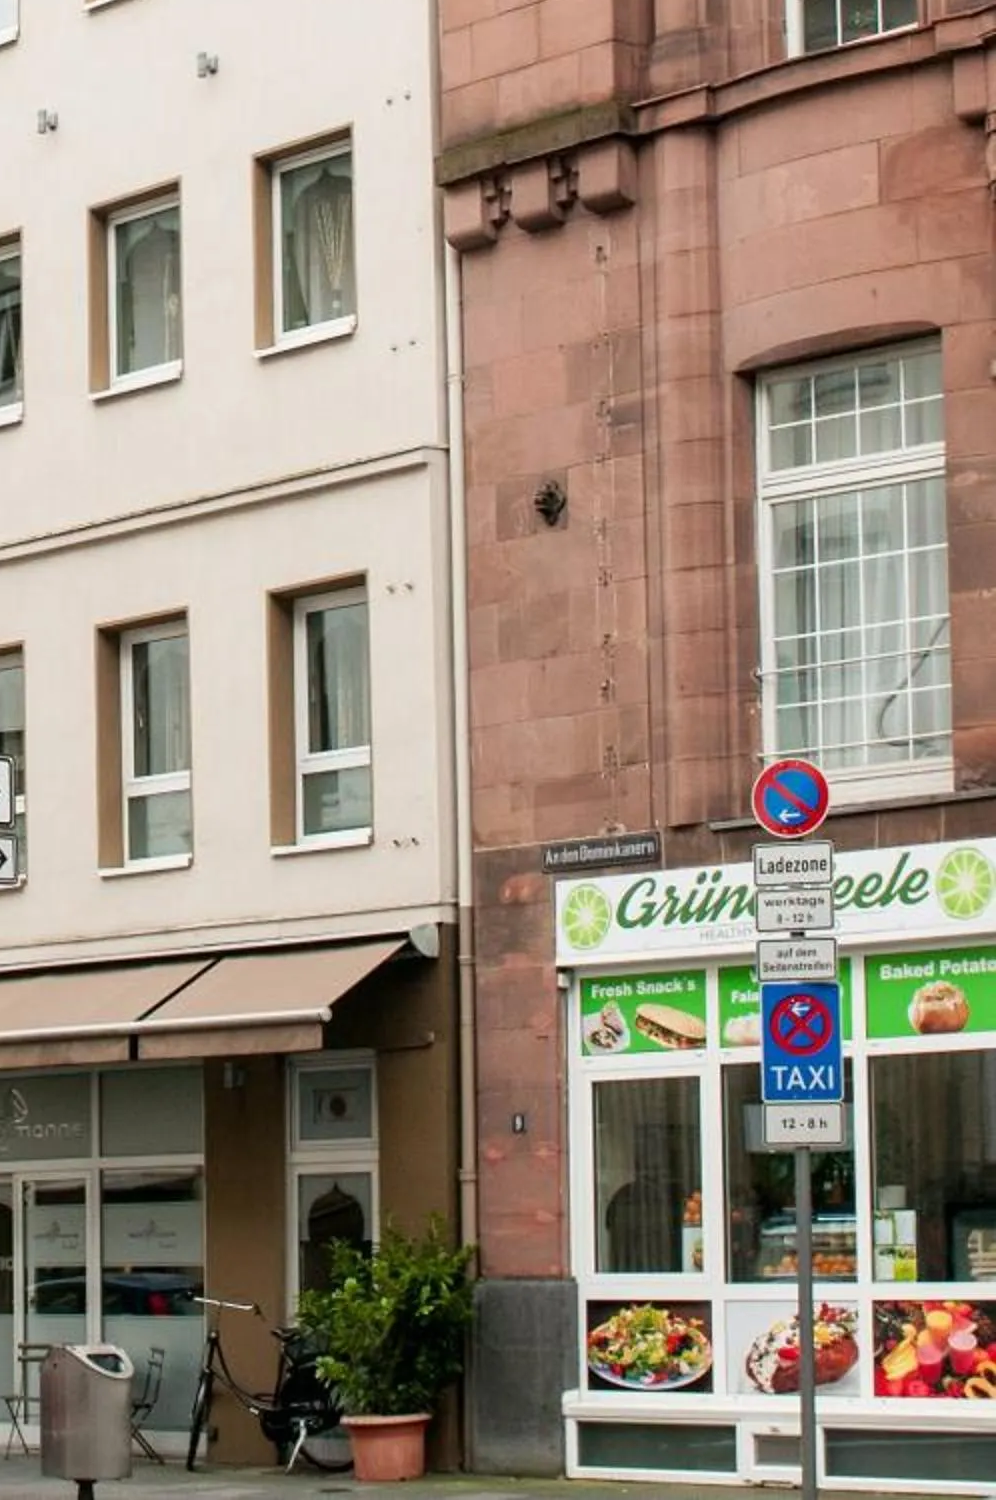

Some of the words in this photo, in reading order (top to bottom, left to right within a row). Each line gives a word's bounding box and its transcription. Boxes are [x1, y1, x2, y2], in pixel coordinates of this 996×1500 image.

[759, 857, 827, 875] Ladezone
[616, 870, 755, 929] Grün
[833, 852, 930, 910] eele
[879, 961, 934, 980] Baked
[590, 981, 633, 999] Fresh
[769, 1065, 835, 1091] TAXI
[782, 1117, 796, 1129] 12
